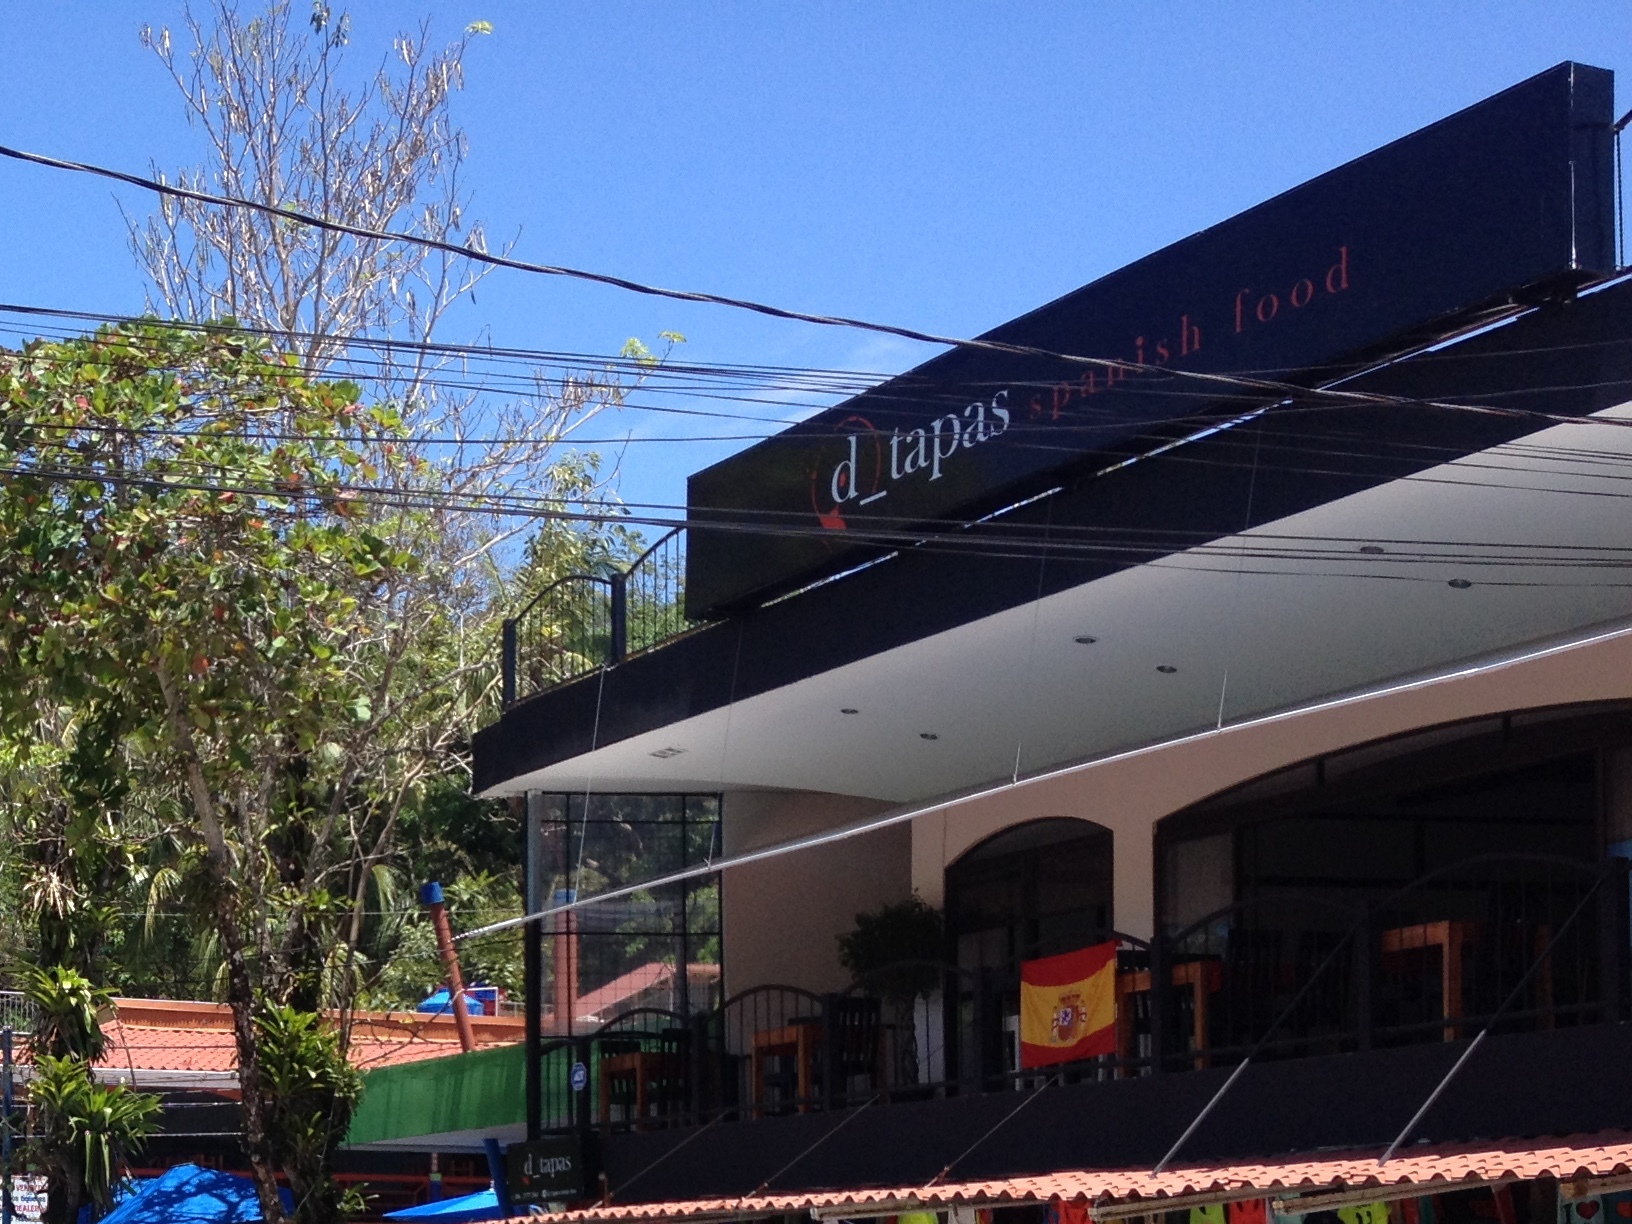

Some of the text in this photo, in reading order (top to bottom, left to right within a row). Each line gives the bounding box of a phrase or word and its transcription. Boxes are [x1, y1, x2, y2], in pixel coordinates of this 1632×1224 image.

[1029, 314, 1202, 420] spanish
[1234, 246, 1350, 334] food
[524, 1153, 572, 1178] d_tapas
